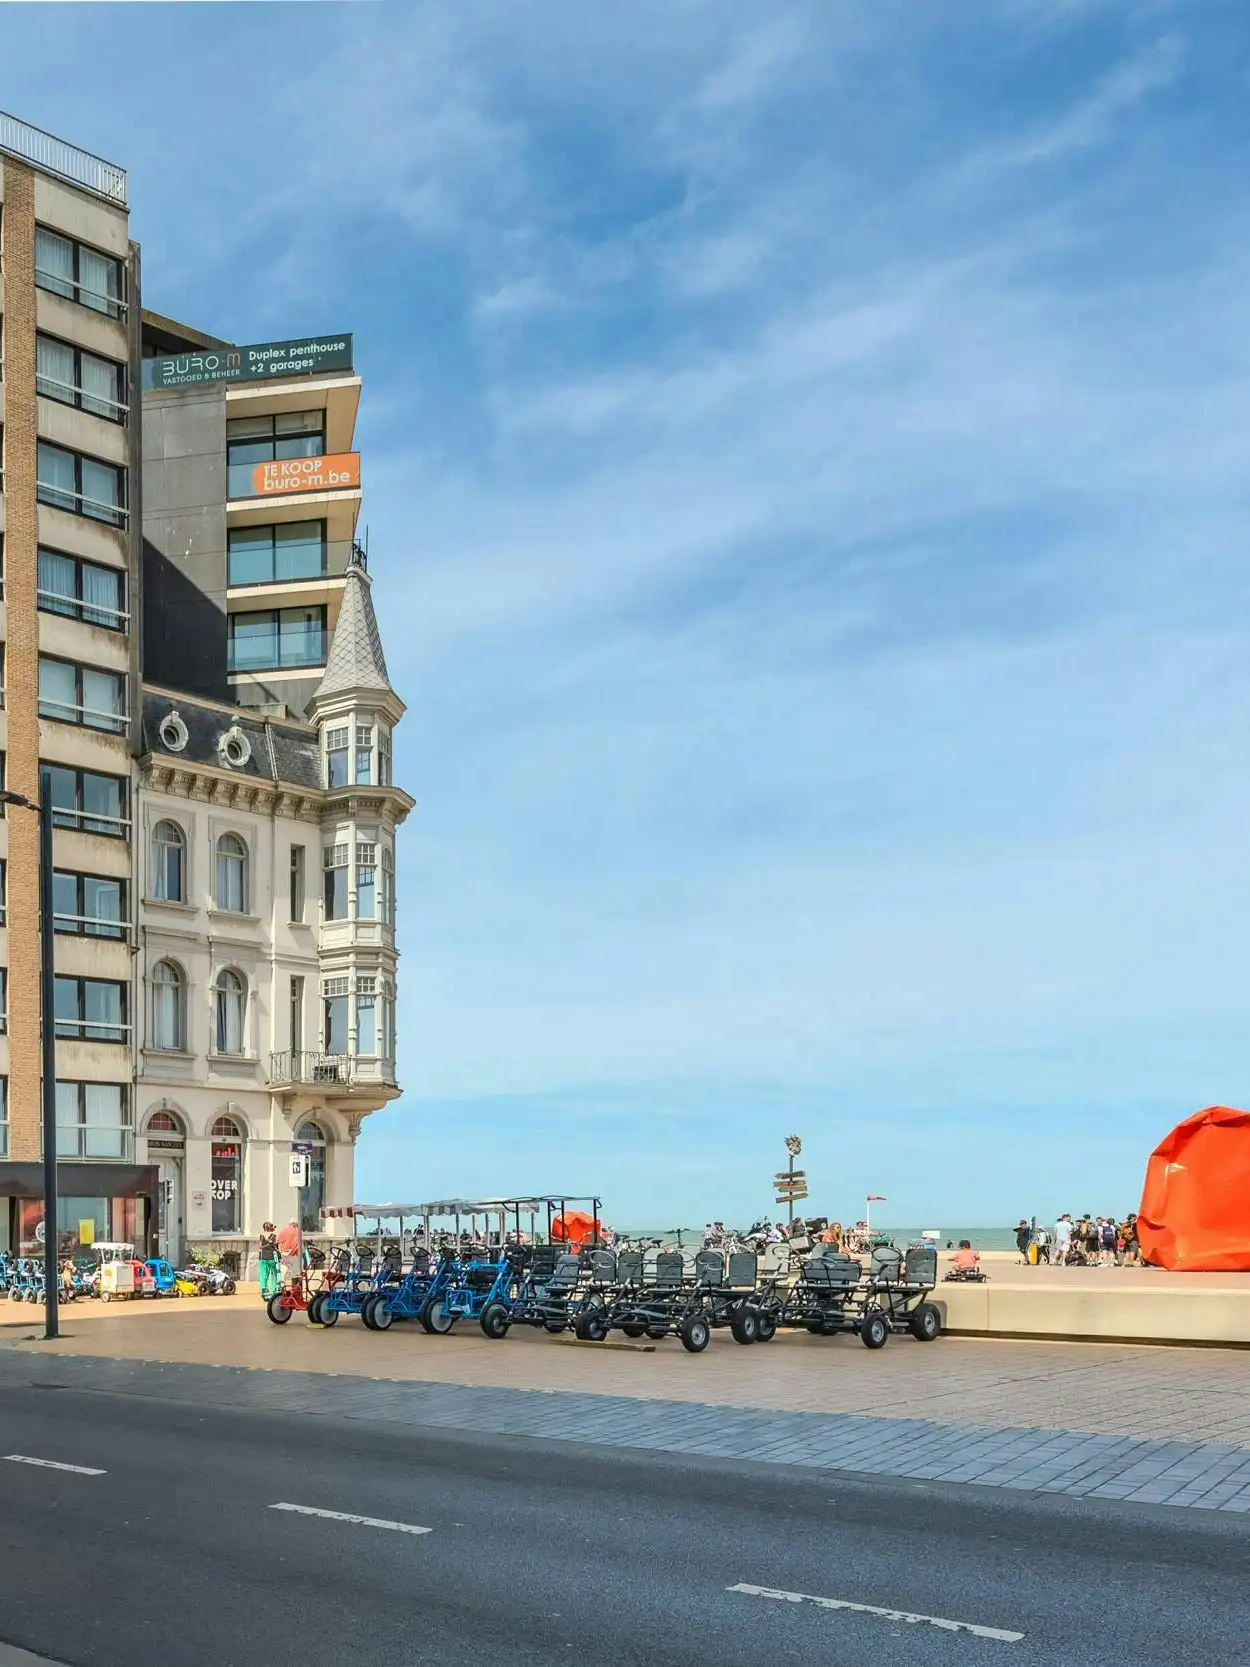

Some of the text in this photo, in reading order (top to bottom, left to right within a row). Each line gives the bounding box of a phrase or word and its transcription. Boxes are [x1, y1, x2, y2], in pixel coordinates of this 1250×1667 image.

[249, 341, 346, 363] Duplex penthouse
[250, 357, 314, 373] +2 garages
[163, 374, 202, 385] VASTGOED
[212, 369, 241, 379] BEHEER
[263, 460, 323, 477] TE KOOP
[264, 470, 350, 491] buro-m.be
[210, 1180, 238, 1190] OVER
